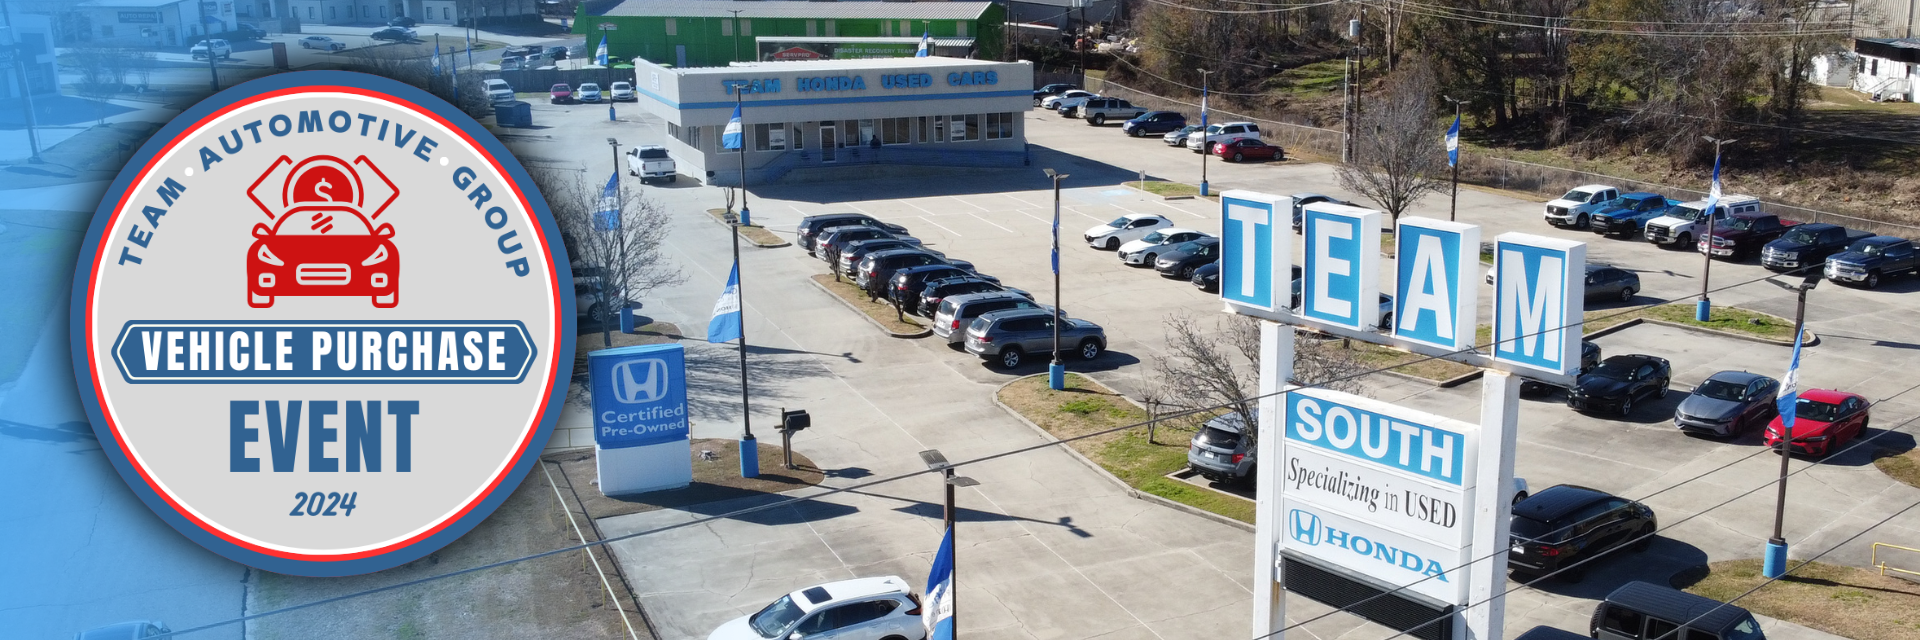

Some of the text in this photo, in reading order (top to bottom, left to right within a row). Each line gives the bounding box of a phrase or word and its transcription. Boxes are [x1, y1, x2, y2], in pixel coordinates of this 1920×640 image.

[722, 71, 998, 95] TEAM HONDA USED CARS
[1228, 203, 1563, 363] TEAM
[601, 402, 684, 424] Certified
[601, 418, 685, 437] Pre-Owned
[1295, 398, 1454, 478] SOUTH
[1288, 457, 1456, 529] Specializing in USED
[1325, 526, 1450, 583] HONDA
